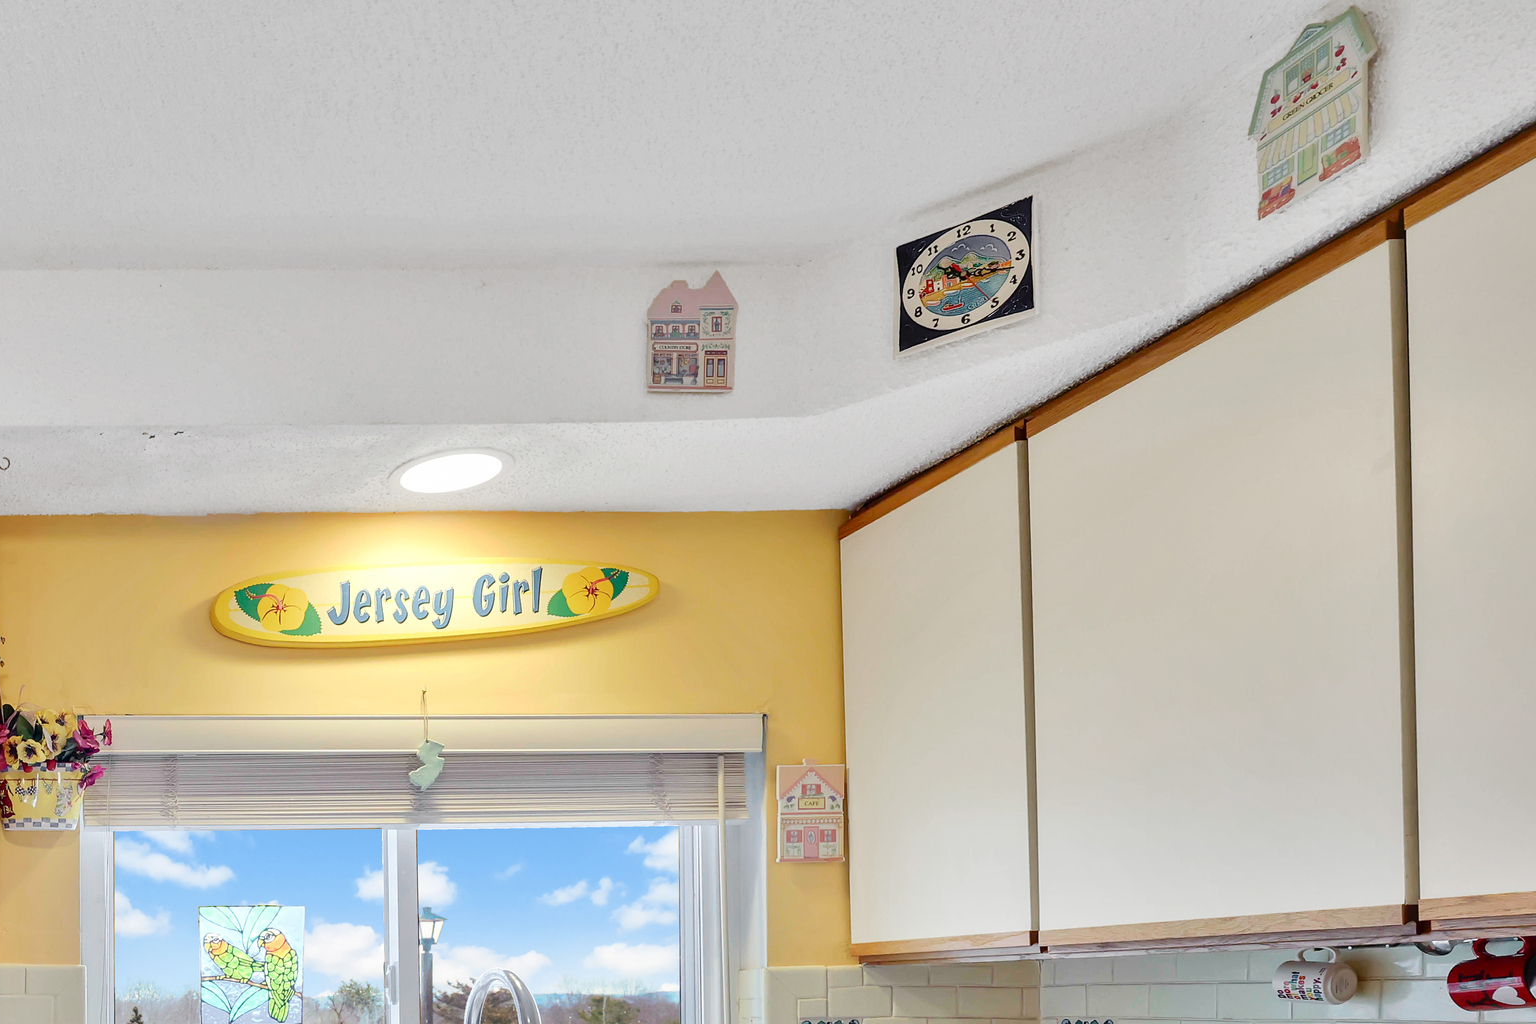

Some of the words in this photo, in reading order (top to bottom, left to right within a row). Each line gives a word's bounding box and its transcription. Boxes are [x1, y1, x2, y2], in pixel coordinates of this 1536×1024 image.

[1282, 103, 1305, 121] GREEN
[1305, 82, 1334, 105] GROCER
[956, 225, 971, 238] 12
[990, 224, 996, 232] 1
[1007, 231, 1017, 242] 2
[927, 245, 939, 256] 11
[1015, 249, 1026, 261] 3
[911, 264, 923, 276] 10
[1009, 275, 1018, 284] 4
[907, 289, 915, 299] 9
[990, 297, 1000, 308] 5
[914, 307, 922, 317] 8
[932, 318, 939, 328] 7
[961, 314, 971, 324] 6
[326, 580, 454, 629] Jersey
[473, 566, 543, 618] Girl
[1289, 971, 1300, 991] what
[1283, 981, 1293, 999] more
[1296, 975, 1309, 1001] makes
